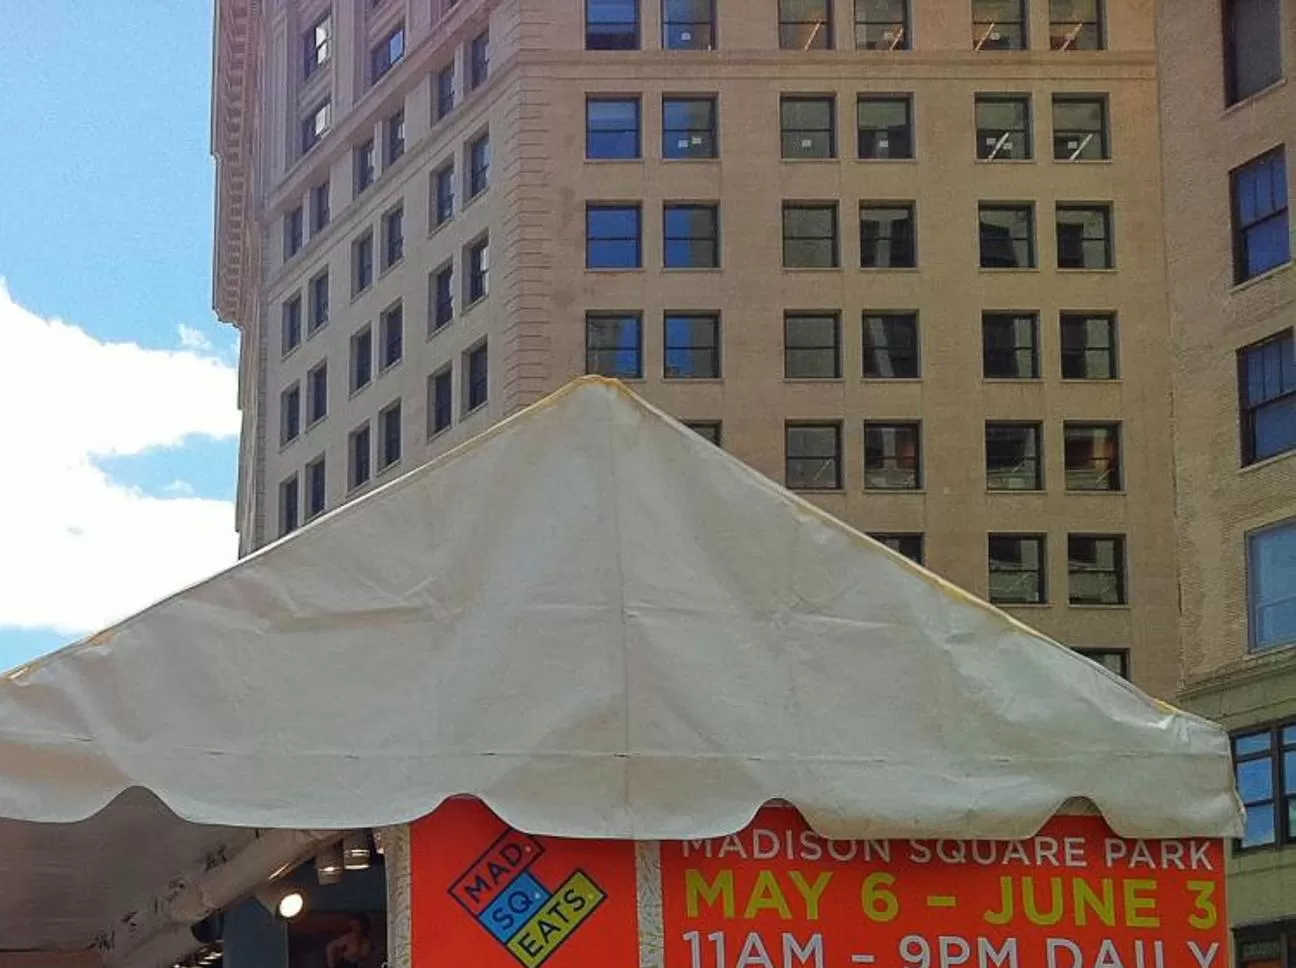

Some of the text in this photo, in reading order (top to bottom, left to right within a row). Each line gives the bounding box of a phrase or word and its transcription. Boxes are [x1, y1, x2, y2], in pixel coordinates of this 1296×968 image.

[464, 843, 532, 904] MAD.
[683, 829, 1214, 870] MADISON SQUARE PARK
[492, 890, 542, 930] SQ.
[685, 869, 833, 920] MAY
[861, 872, 899, 922] 6
[984, 876, 1161, 928] JUNE
[1186, 880, 1217, 929] 3
